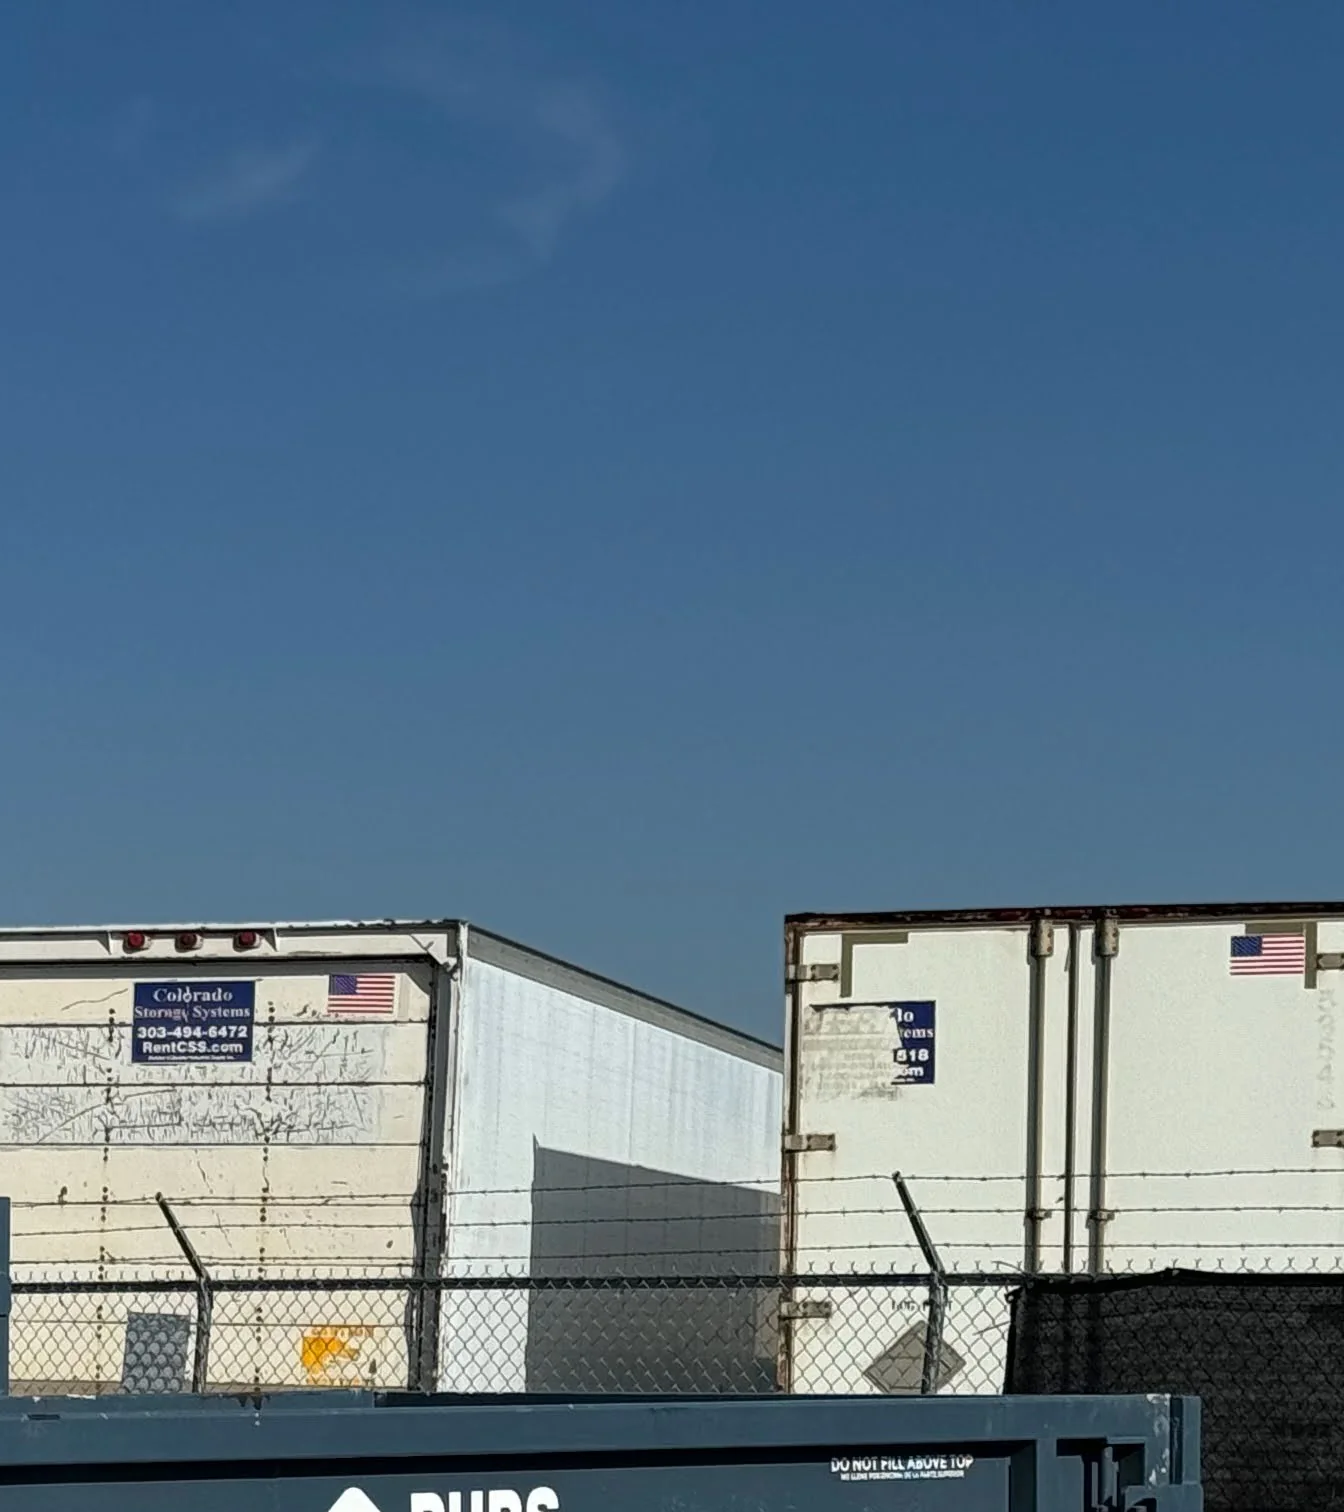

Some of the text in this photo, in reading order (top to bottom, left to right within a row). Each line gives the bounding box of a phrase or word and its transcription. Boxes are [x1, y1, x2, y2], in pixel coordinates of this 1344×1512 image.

[153, 986, 233, 1002] Colorado
[192, 1005, 250, 1020] Systems
[137, 1025, 248, 1039] 303-494-6472
[142, 1041, 243, 1053] RentCSS.com
[831, 1454, 974, 1472] DO NOT FILL ABOVE TOP
